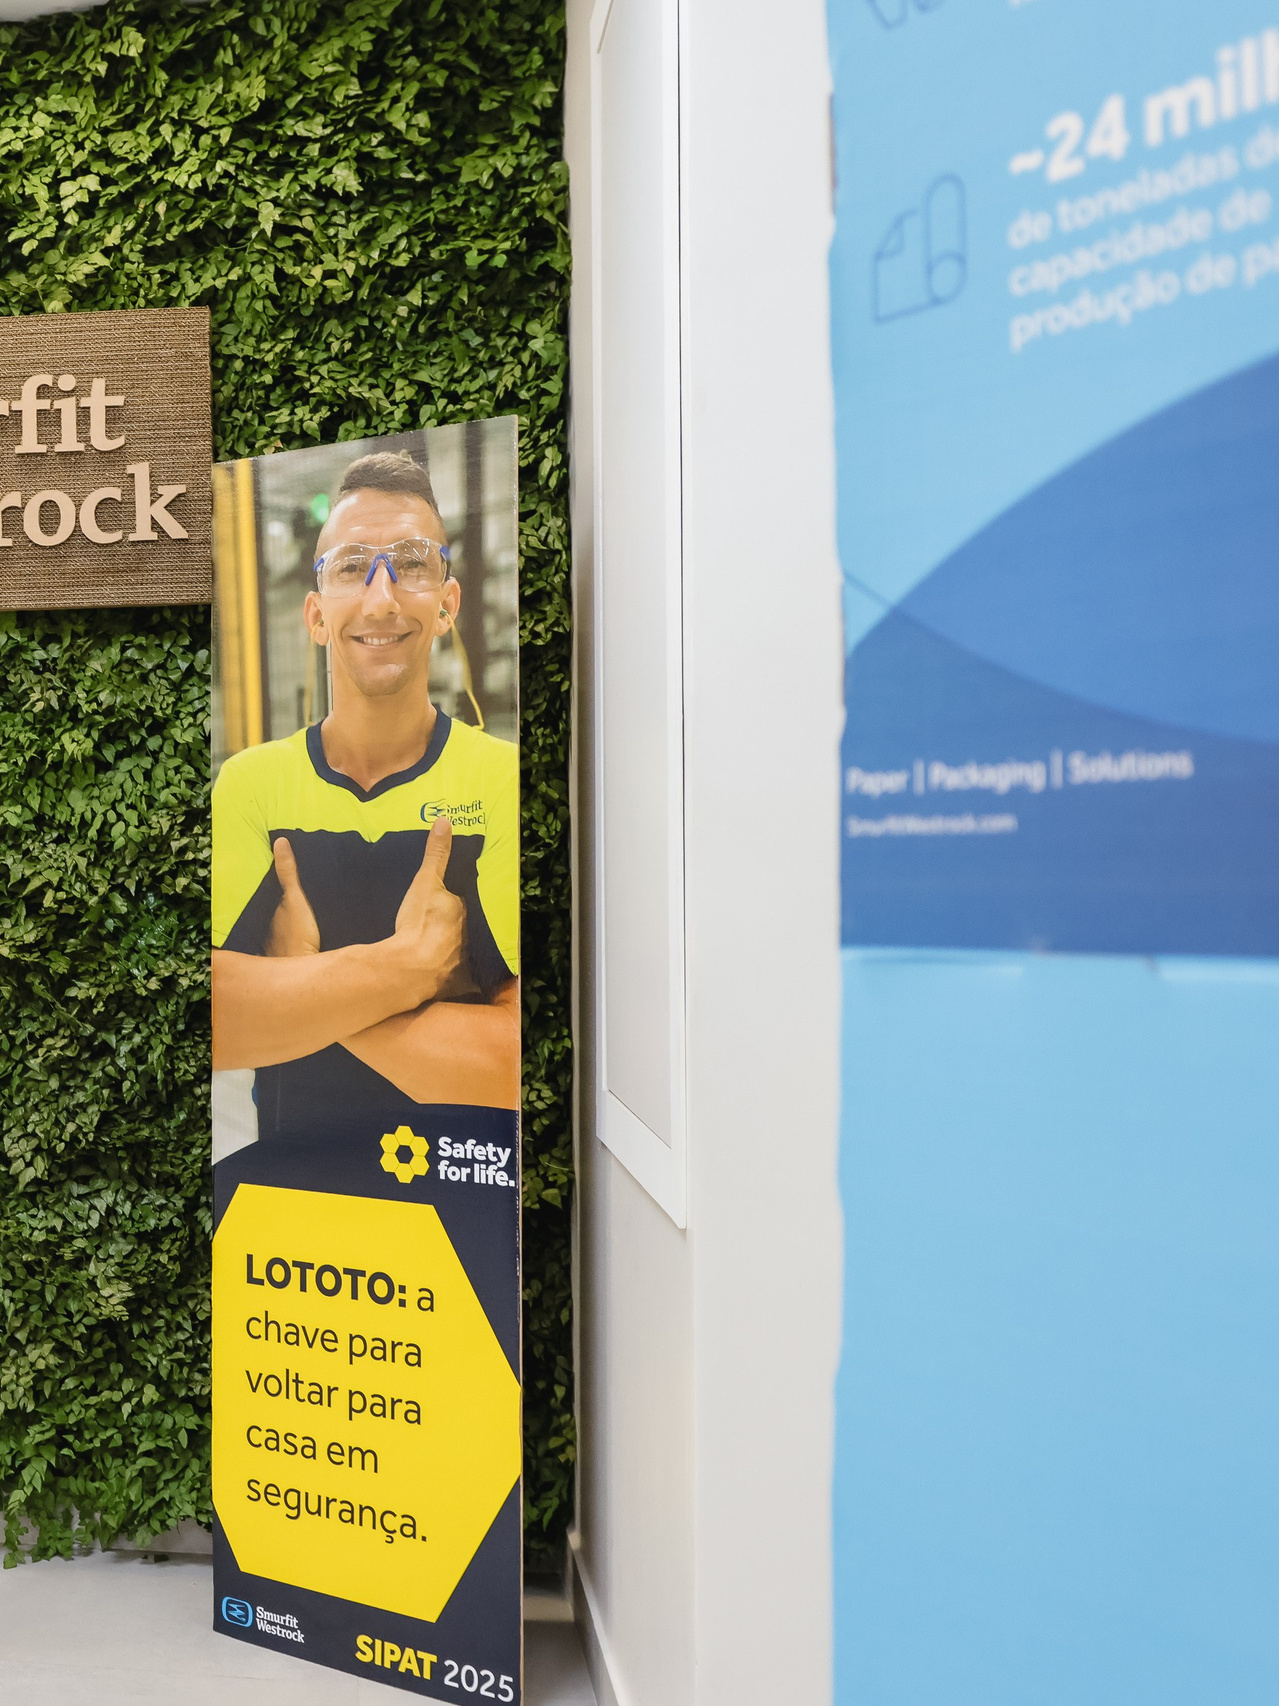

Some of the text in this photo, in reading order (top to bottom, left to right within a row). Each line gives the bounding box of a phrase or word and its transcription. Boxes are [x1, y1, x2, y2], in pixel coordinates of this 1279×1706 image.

[1009, 211, 1053, 249] de
[1057, 147, 1239, 232] toneladas
[1009, 188, 1272, 297] capacidade de
[1010, 270, 1181, 352] produção
[1185, 252, 1237, 295] de
[1067, 749, 1195, 785] Solutions
[437, 1136, 512, 1168] Safety
[437, 1159, 516, 1187] for life.
[245, 1253, 435, 1313] LOTOTO: a
[245, 1310, 423, 1368] chave para
[245, 1368, 422, 1425] voltar para
[246, 1425, 379, 1474] casa em
[246, 1478, 429, 1544] segurança.
[255, 1617, 305, 1644] Westrock
[256, 1605, 299, 1629] Smurfit
[355, 1633, 515, 1703] SIPAT 2025
